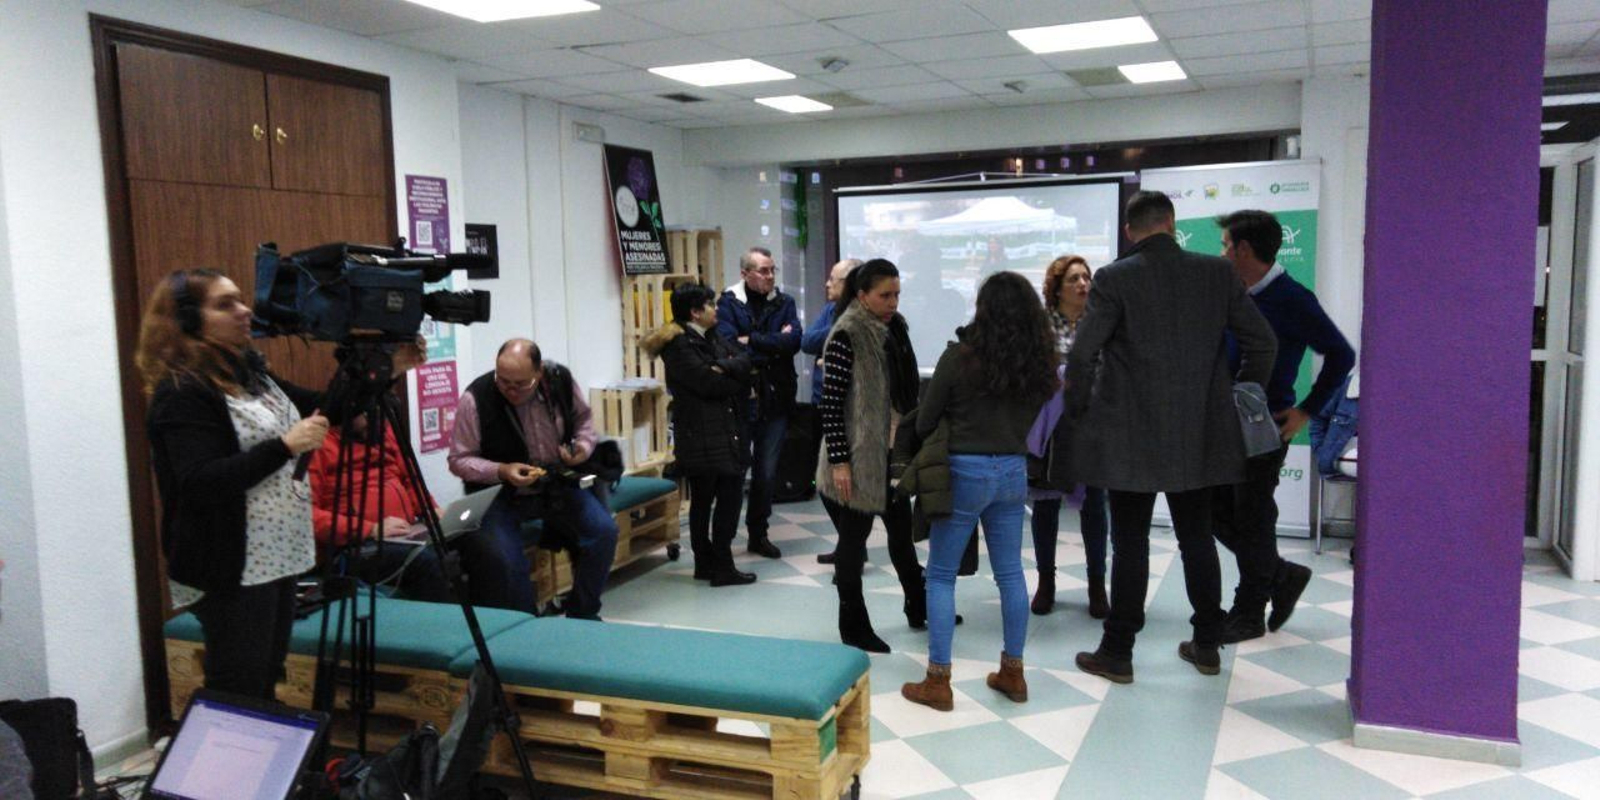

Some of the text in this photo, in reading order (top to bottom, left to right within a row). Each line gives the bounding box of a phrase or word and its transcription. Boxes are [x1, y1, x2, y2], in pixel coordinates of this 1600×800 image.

[621, 231, 651, 240] MUJERES
[623, 241, 661, 250] Y MENORES
[626, 252, 665, 261] ASESINADAS
